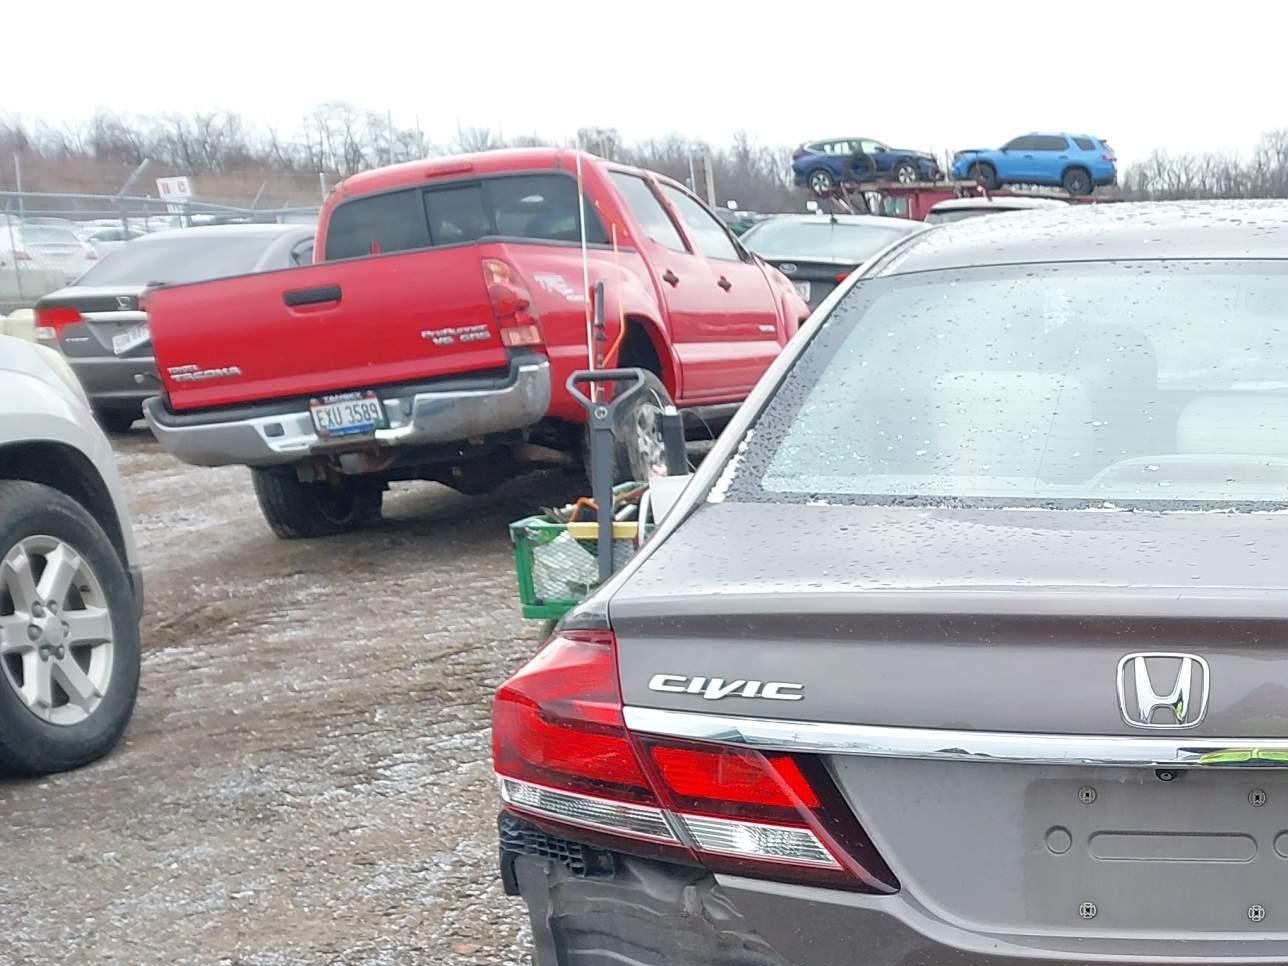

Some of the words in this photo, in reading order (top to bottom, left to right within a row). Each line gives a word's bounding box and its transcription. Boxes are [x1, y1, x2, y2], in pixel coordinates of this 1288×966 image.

[170, 366, 241, 382] TACOMA
[317, 406, 342, 427] EXU
[345, 402, 379, 424] 3589
[649, 674, 805, 700] CIVIC
